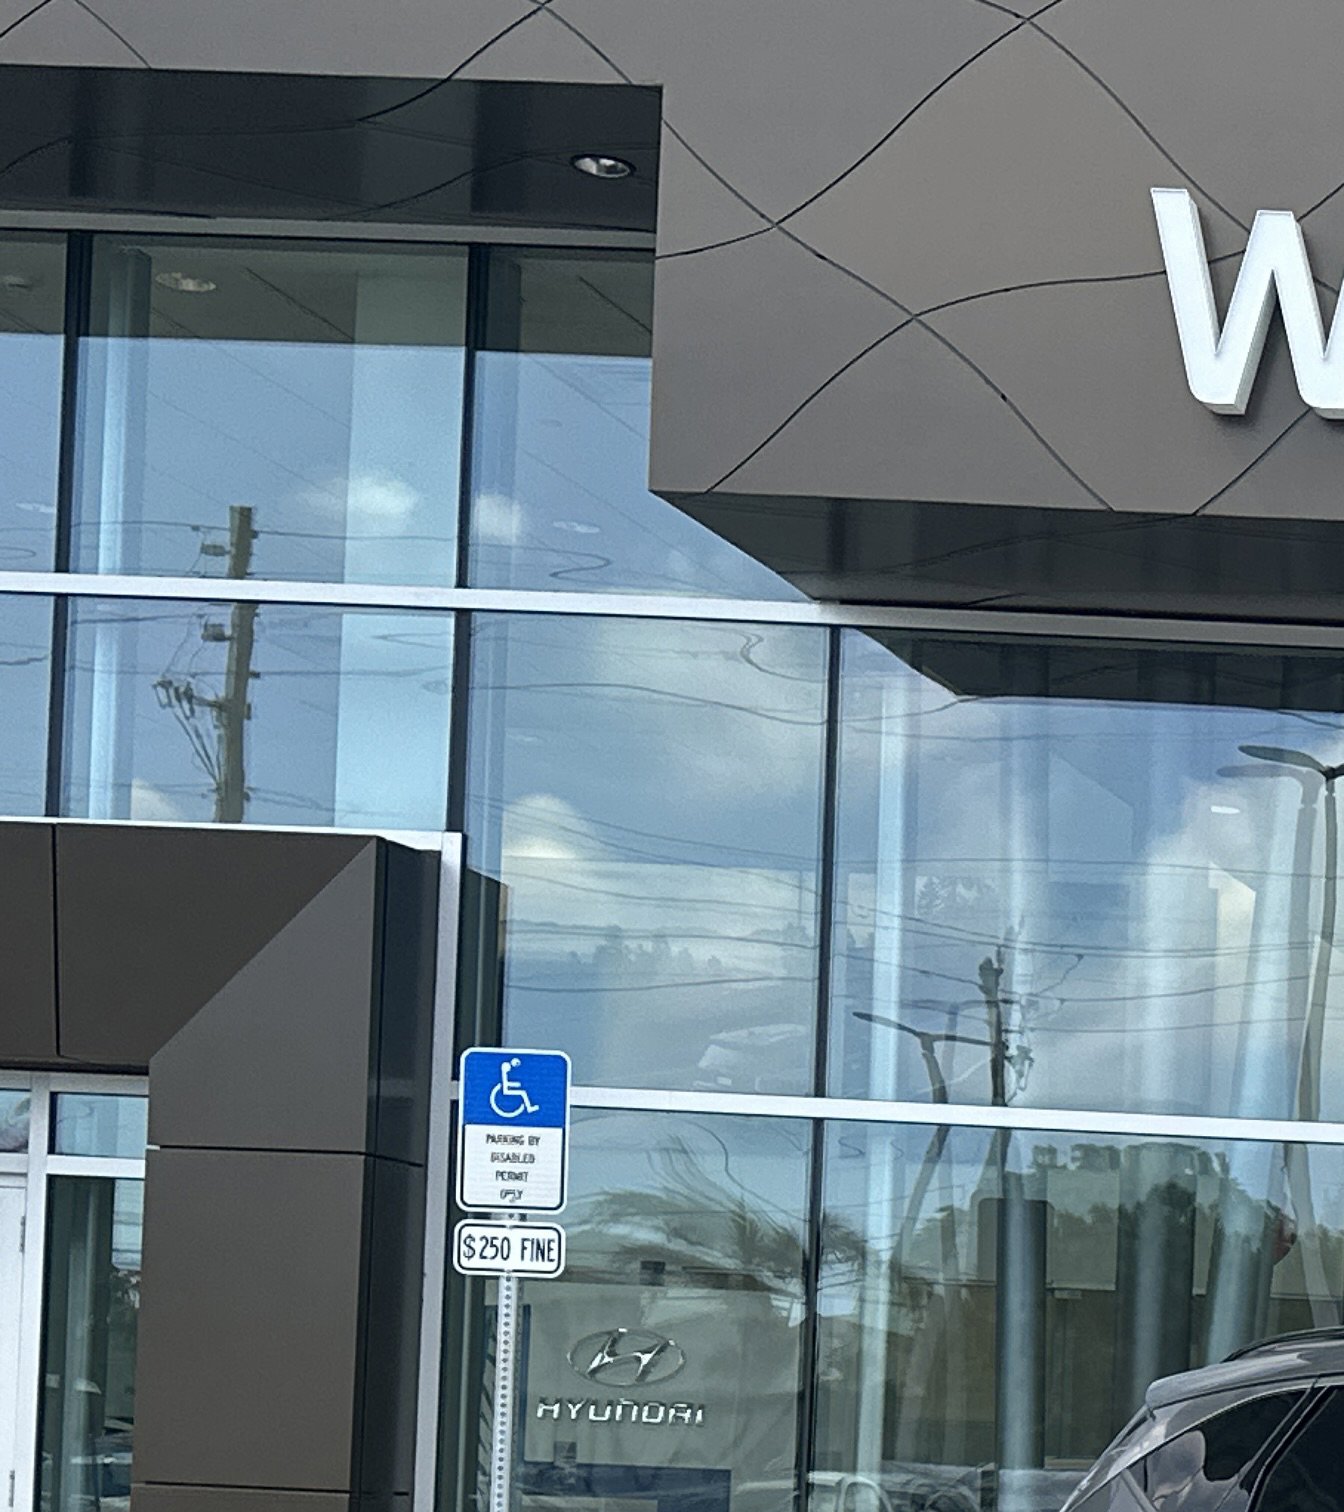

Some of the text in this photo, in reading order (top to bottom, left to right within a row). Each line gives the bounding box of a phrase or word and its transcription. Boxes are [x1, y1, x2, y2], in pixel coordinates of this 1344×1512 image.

[462, 1233, 556, 1263] $250 FINE
[536, 1398, 705, 1426] HYUNDAI
